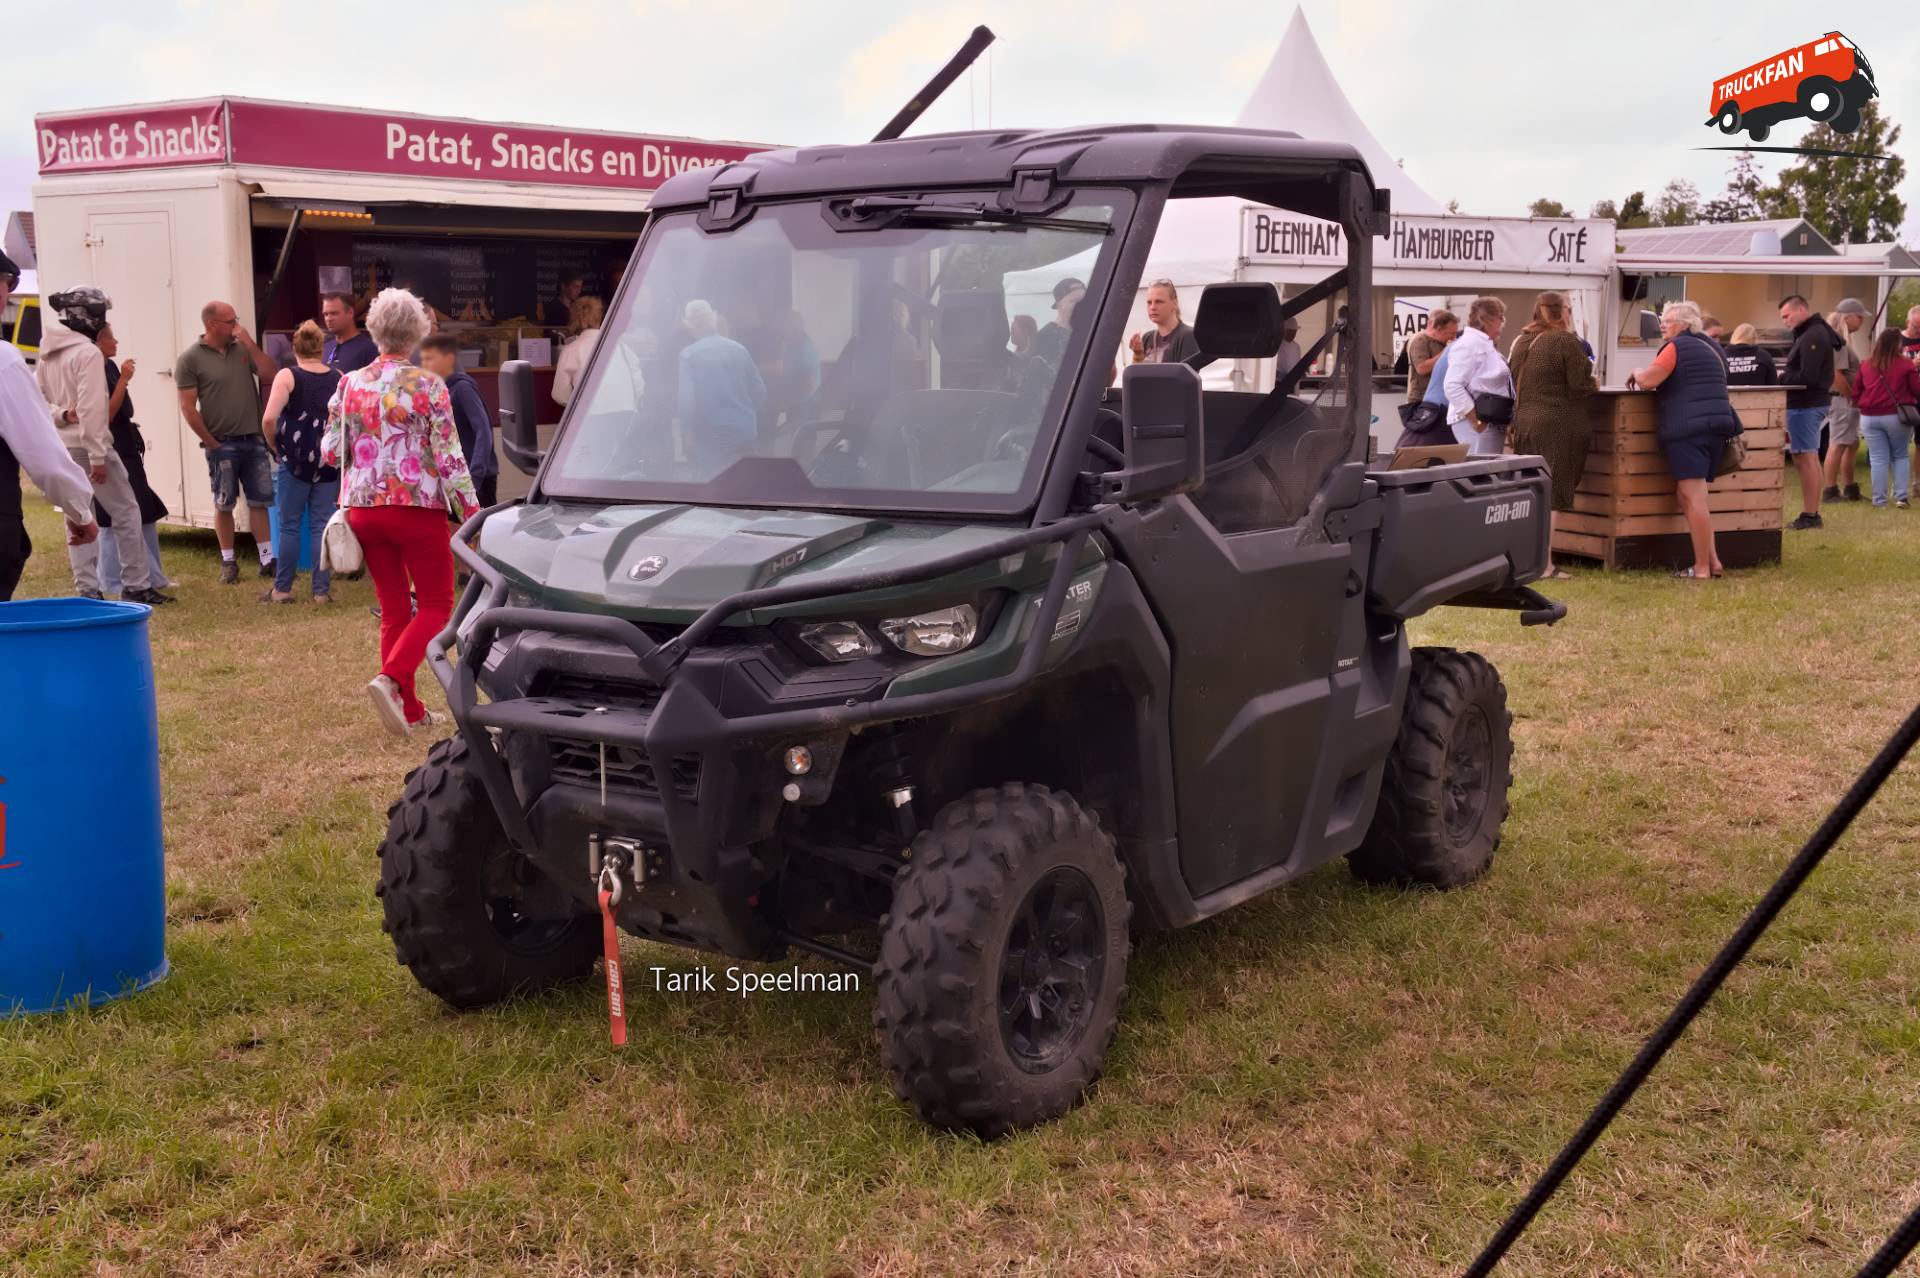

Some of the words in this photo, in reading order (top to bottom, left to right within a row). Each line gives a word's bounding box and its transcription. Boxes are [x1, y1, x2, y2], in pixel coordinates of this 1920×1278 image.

[41, 129, 104, 164] Patat
[109, 123, 129, 160] &
[135, 115, 221, 158] Snacks
[387, 123, 482, 171] Patat,
[492, 133, 594, 174] Snacks
[601, 152, 635, 176] en
[1256, 214, 1340, 257] BEENHAM
[1393, 220, 1495, 261] HAMBURGER
[1548, 226, 1588, 263] SATÉ
[608, 959, 622, 1017] can-am
